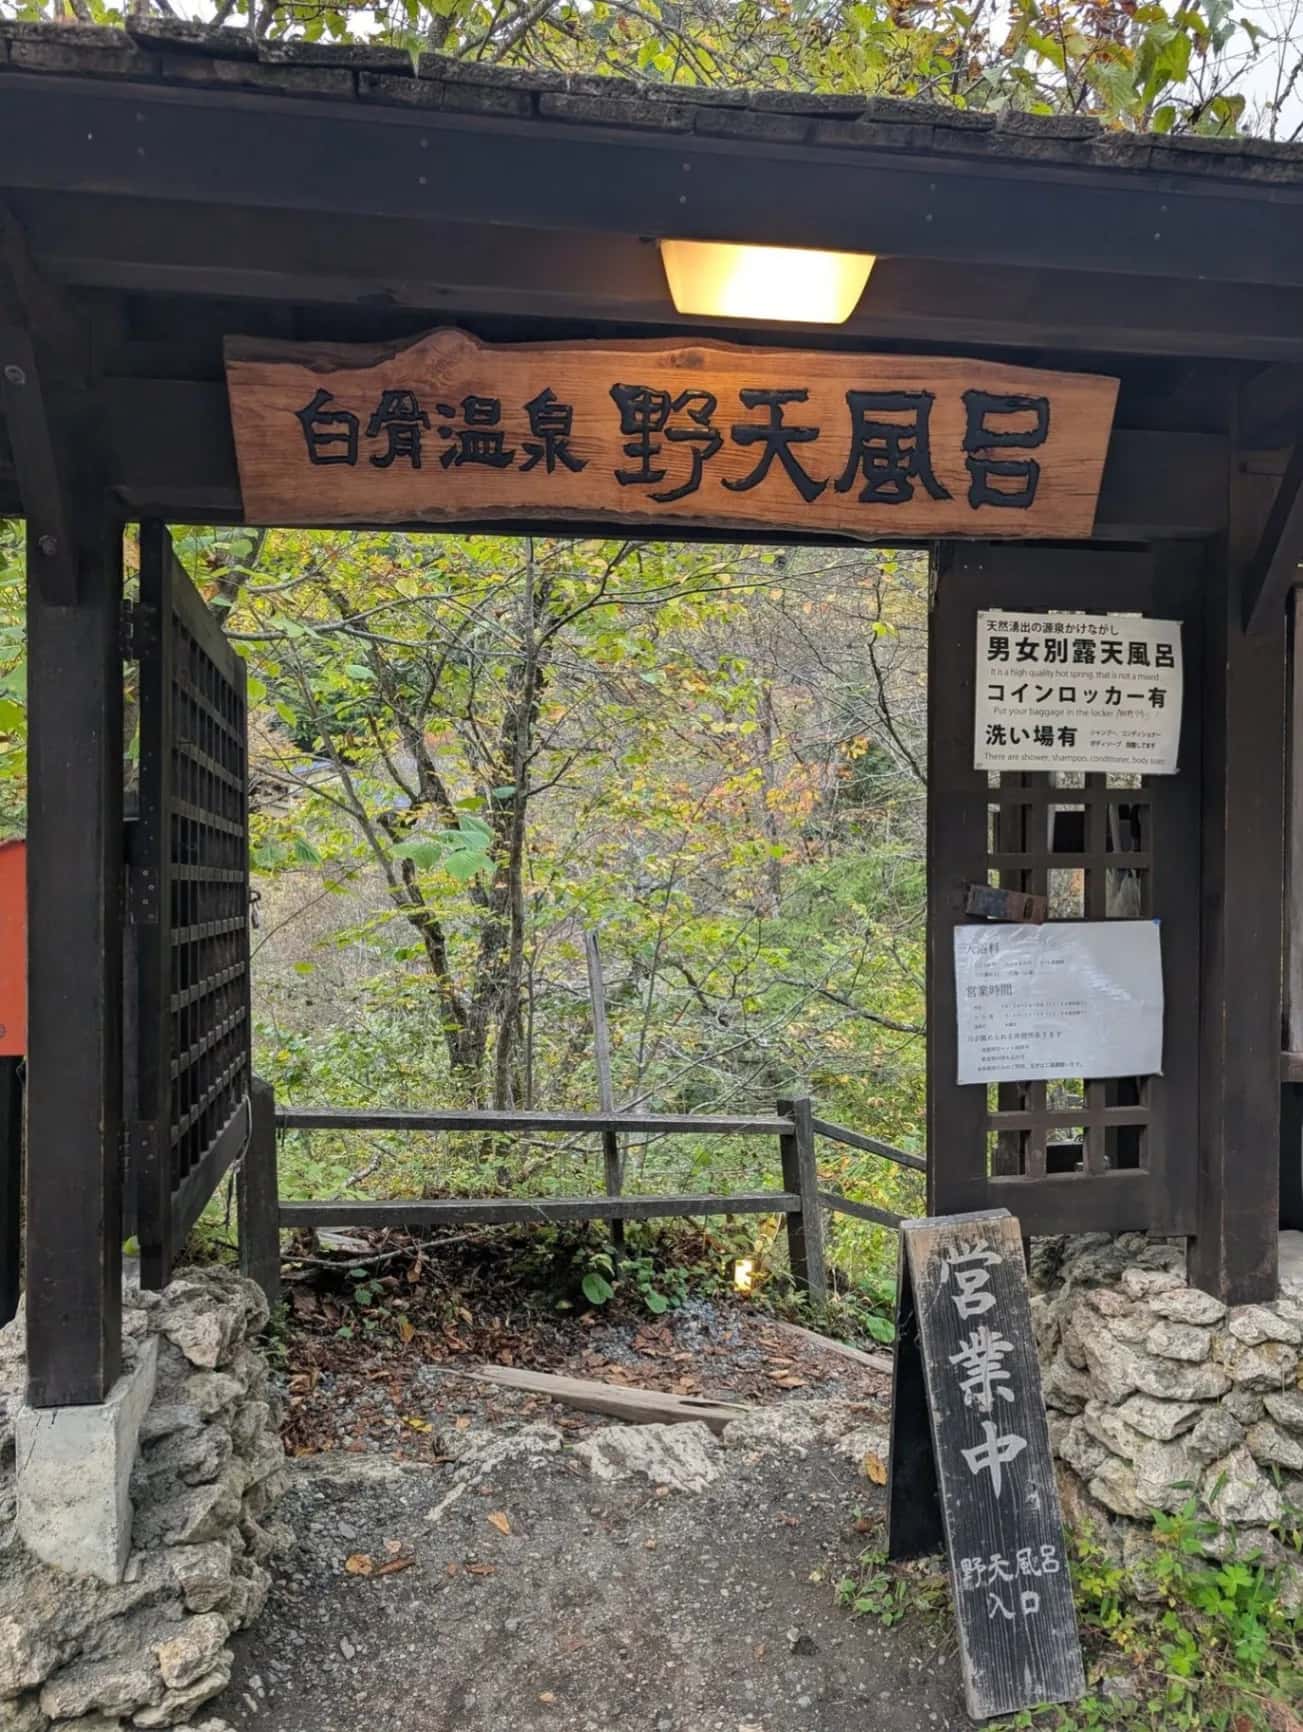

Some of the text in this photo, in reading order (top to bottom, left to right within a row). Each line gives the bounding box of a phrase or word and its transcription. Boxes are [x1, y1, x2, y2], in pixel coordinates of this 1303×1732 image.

[296, 382, 1051, 511] 白骨温泉 野天風呂
[986, 620, 1120, 636] 天然湧出の源泉かけながし
[987, 636, 1175, 668] 男女別露天風呂
[1010, 668, 1027, 680] high
[1055, 670, 1069, 679] hot
[1095, 671, 1111, 680] that
[987, 683, 1167, 709] コインロッカー有
[993, 706, 1007, 716] Put
[1009, 708, 1027, 719] your
[1029, 707, 1064, 720] baggage
[1066, 707, 1074, 717] in
[1075, 707, 1089, 717] the
[1090, 708, 1113, 718] locker
[985, 724, 1078, 748] 洗い場有
[984, 752, 1006, 761] There
[966, 984, 1013, 998] 営業時間
[939, 1238, 1027, 1500] 営業中
[960, 1547, 1060, 1589] 野天風呂
[987, 1590, 1040, 1620] 入口
